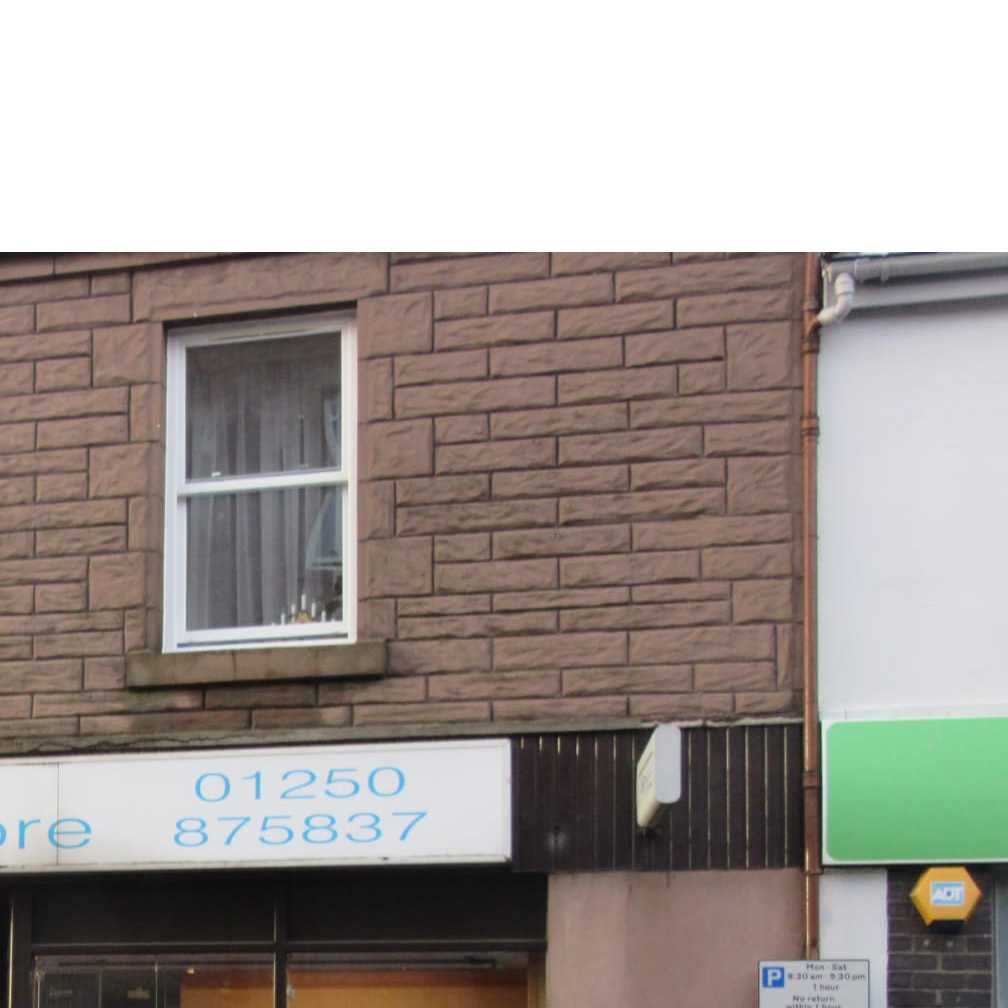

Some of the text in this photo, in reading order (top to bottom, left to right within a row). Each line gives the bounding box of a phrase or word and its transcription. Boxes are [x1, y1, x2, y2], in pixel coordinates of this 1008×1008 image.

[194, 766, 407, 802] 01250
[173, 811, 429, 848] 875837
[767, 969, 782, 986] P
[805, 963, 825, 971] Mon
[831, 963, 848, 971] Sat
